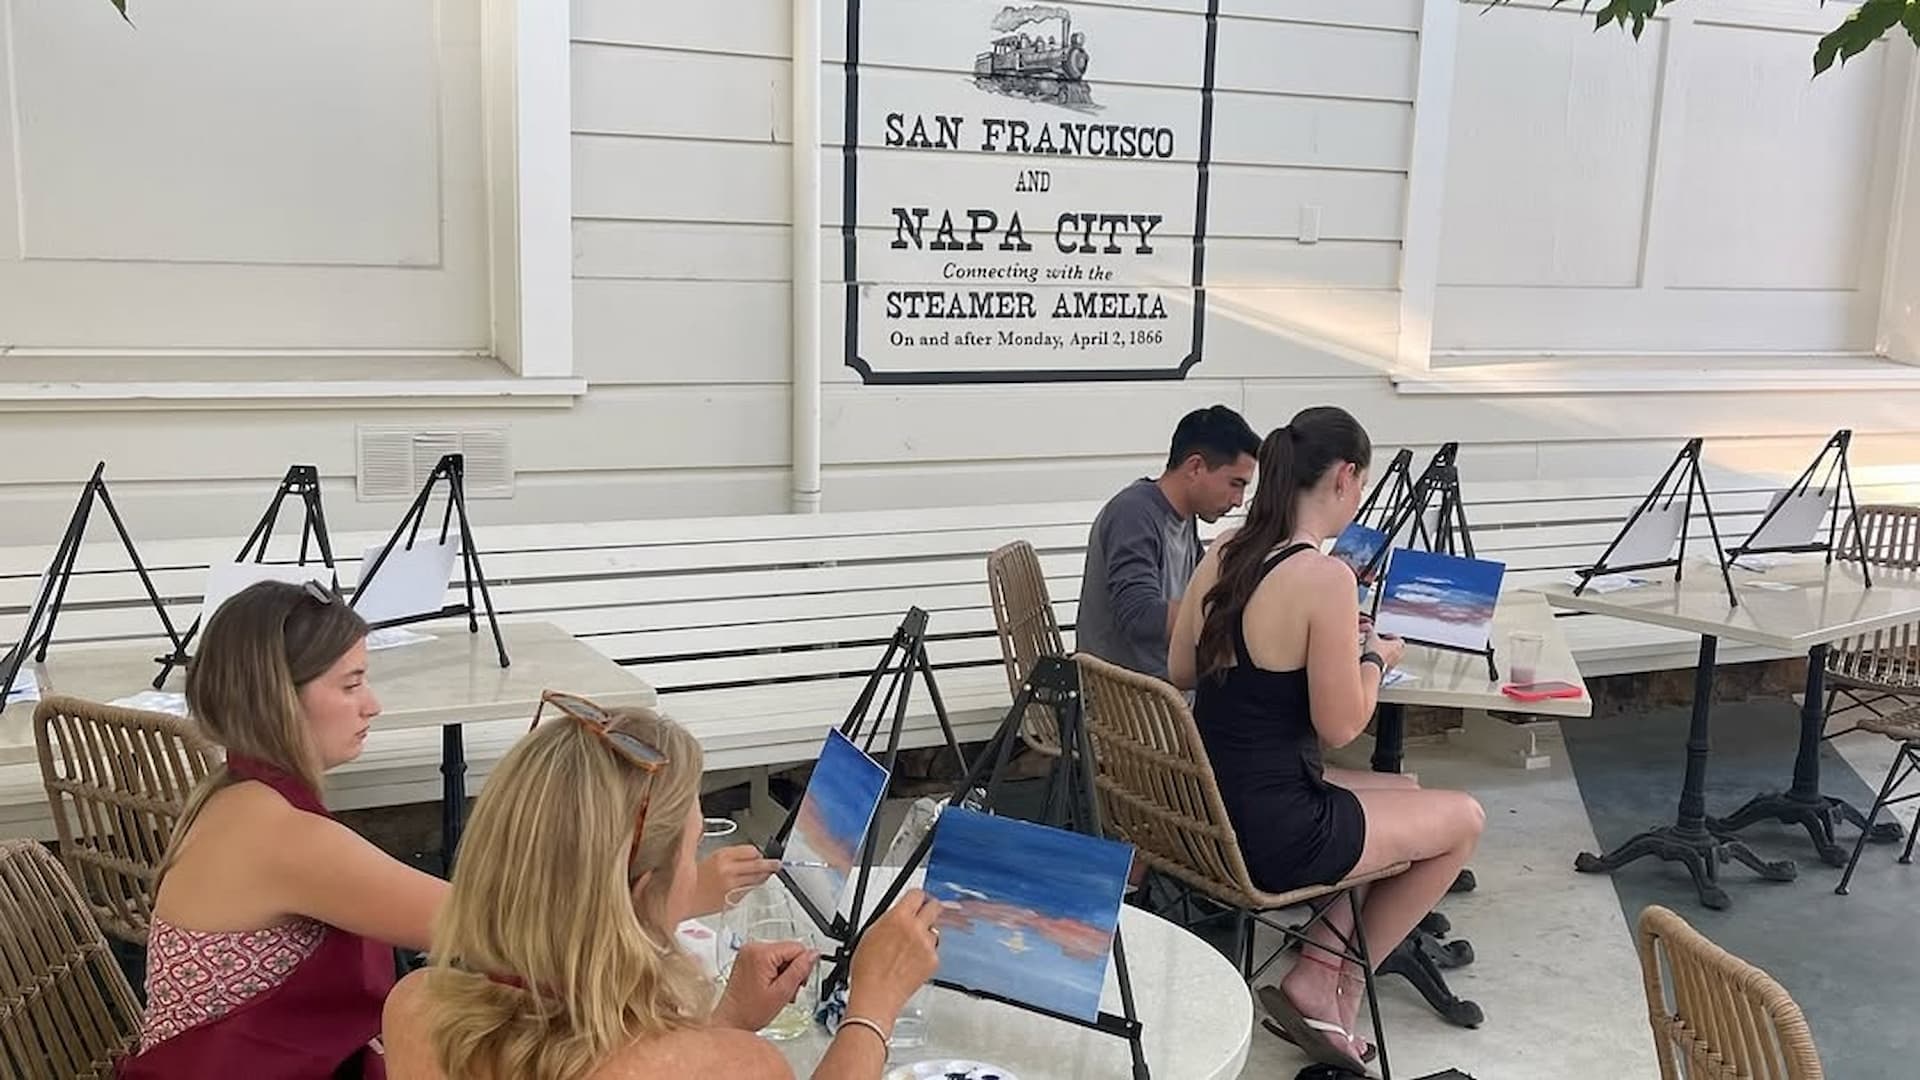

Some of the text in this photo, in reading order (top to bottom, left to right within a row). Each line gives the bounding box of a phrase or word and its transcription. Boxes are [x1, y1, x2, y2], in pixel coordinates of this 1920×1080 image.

[885, 113, 1174, 158] SAN FRANCISCO
[1015, 170, 1051, 192] AND
[891, 207, 1163, 255] NAPA CITY
[943, 262, 1113, 283] Connecting with the
[886, 291, 1168, 319] STEAMER AMELIA
[890, 330, 1163, 350] On and after Monday, April 2, 1866
